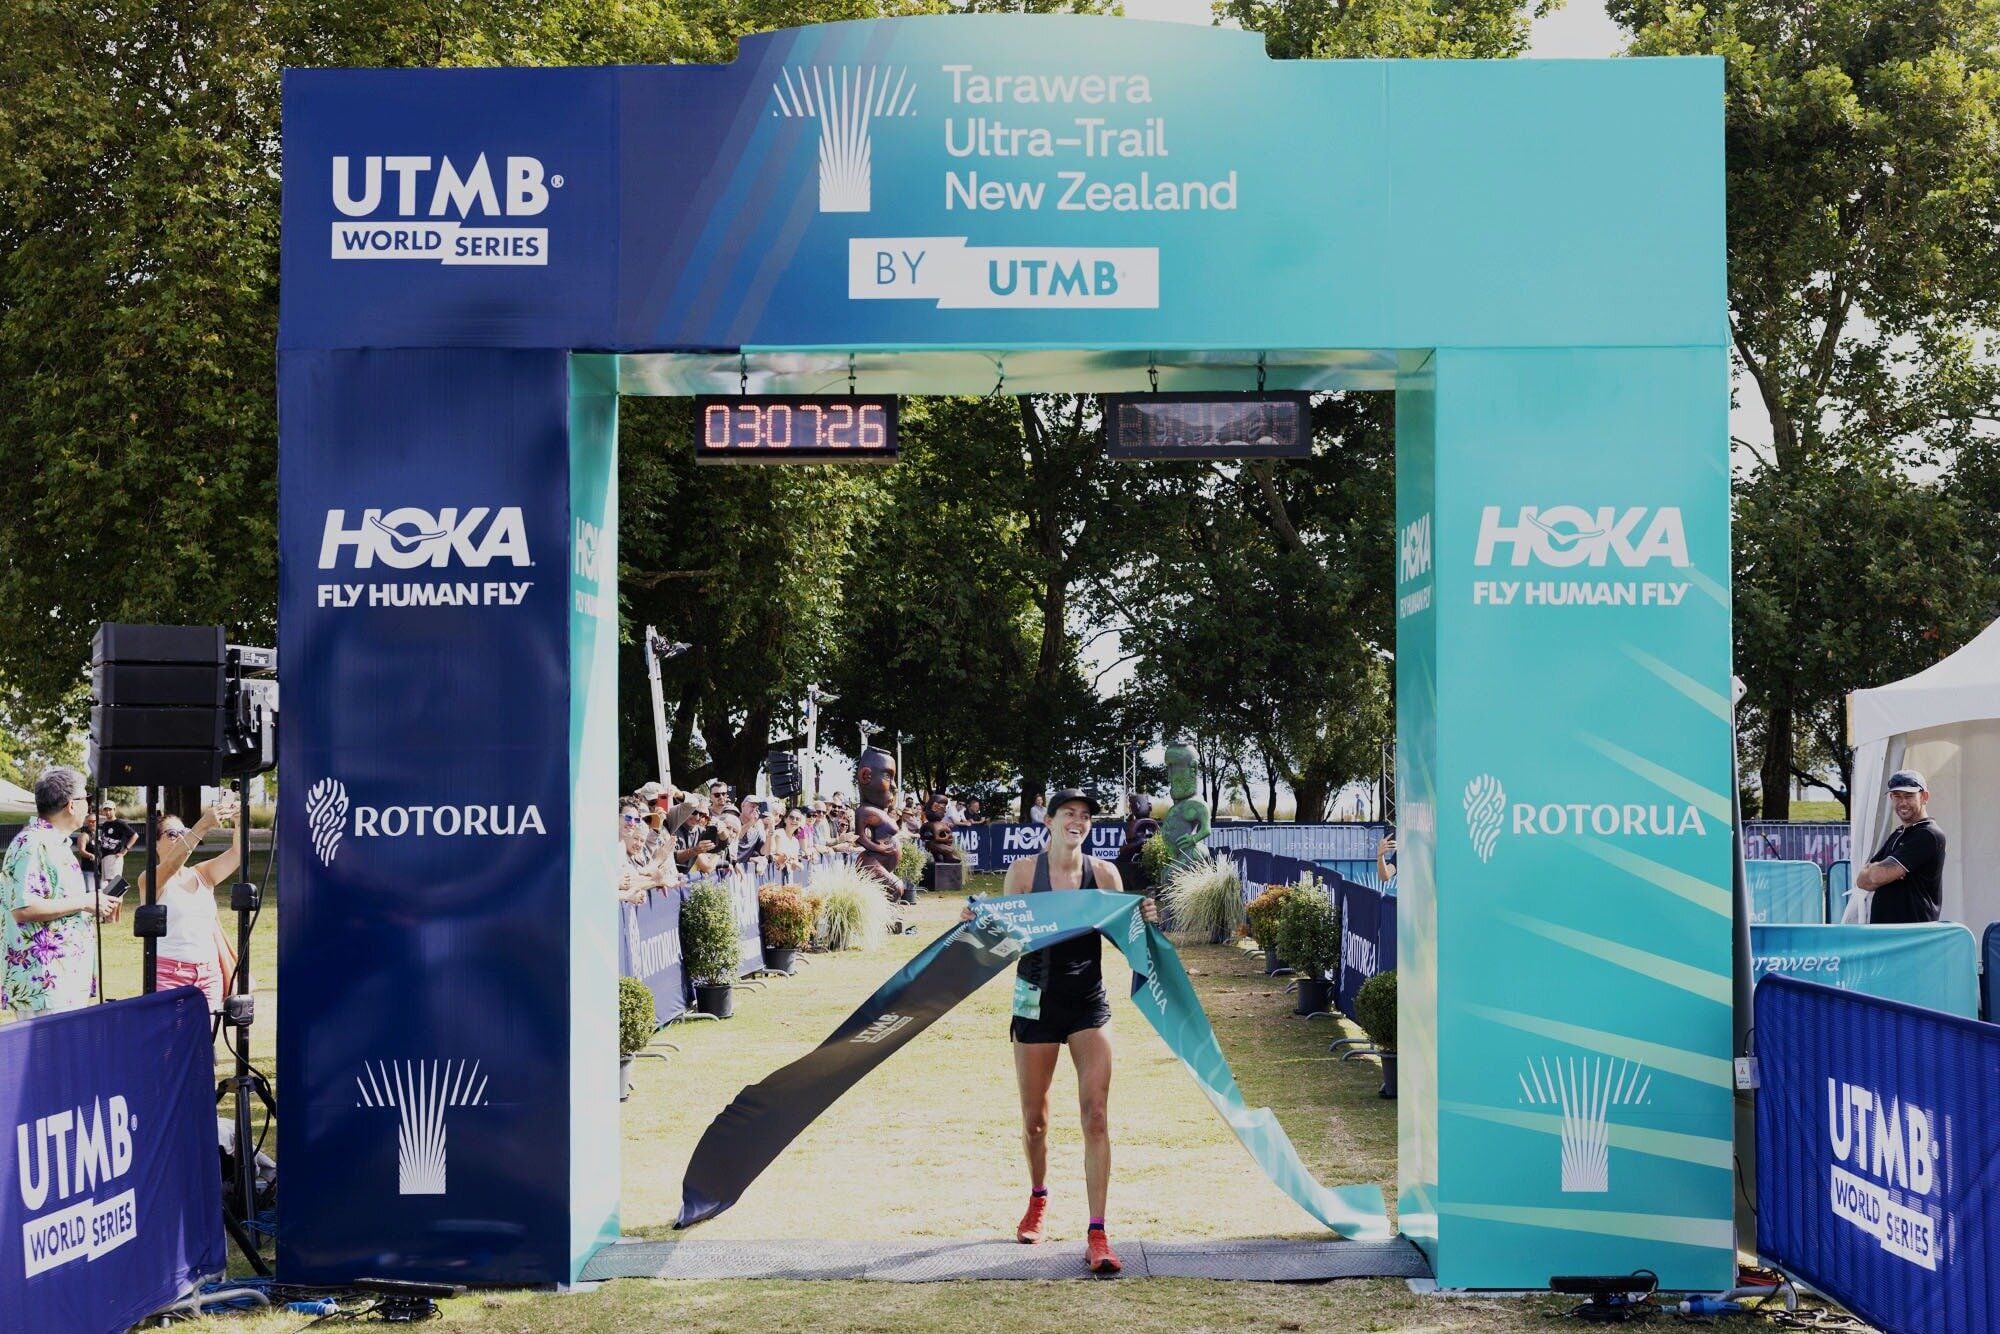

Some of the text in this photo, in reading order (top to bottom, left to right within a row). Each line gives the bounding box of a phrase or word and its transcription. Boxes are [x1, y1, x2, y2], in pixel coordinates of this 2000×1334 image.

[942, 65, 1153, 104] Tarawera
[945, 118, 1169, 157] Ultra-Trail
[945, 170, 1238, 211] New Zealand
[342, 231, 539, 257] WORLD SERIES
[877, 251, 1119, 297] BY UTMB
[705, 404, 884, 448] 03:07:26
[318, 507, 532, 569] HOKA
[1400, 512, 1432, 584] HOKA
[1474, 505, 1690, 567] HOKA
[317, 582, 531, 608] FLY HUMAN FLY
[1473, 581, 1689, 606] FLY HUMAN FLY
[354, 804, 547, 837] ROTORUA
[1512, 803, 1707, 836] ROTORUA
[952, 830, 979, 851] TMB
[849, 1013, 900, 1043] UTMB
[30, 1201, 132, 1262] WORLD SERIES
[1834, 1177, 1929, 1257] WORLD SERIES
